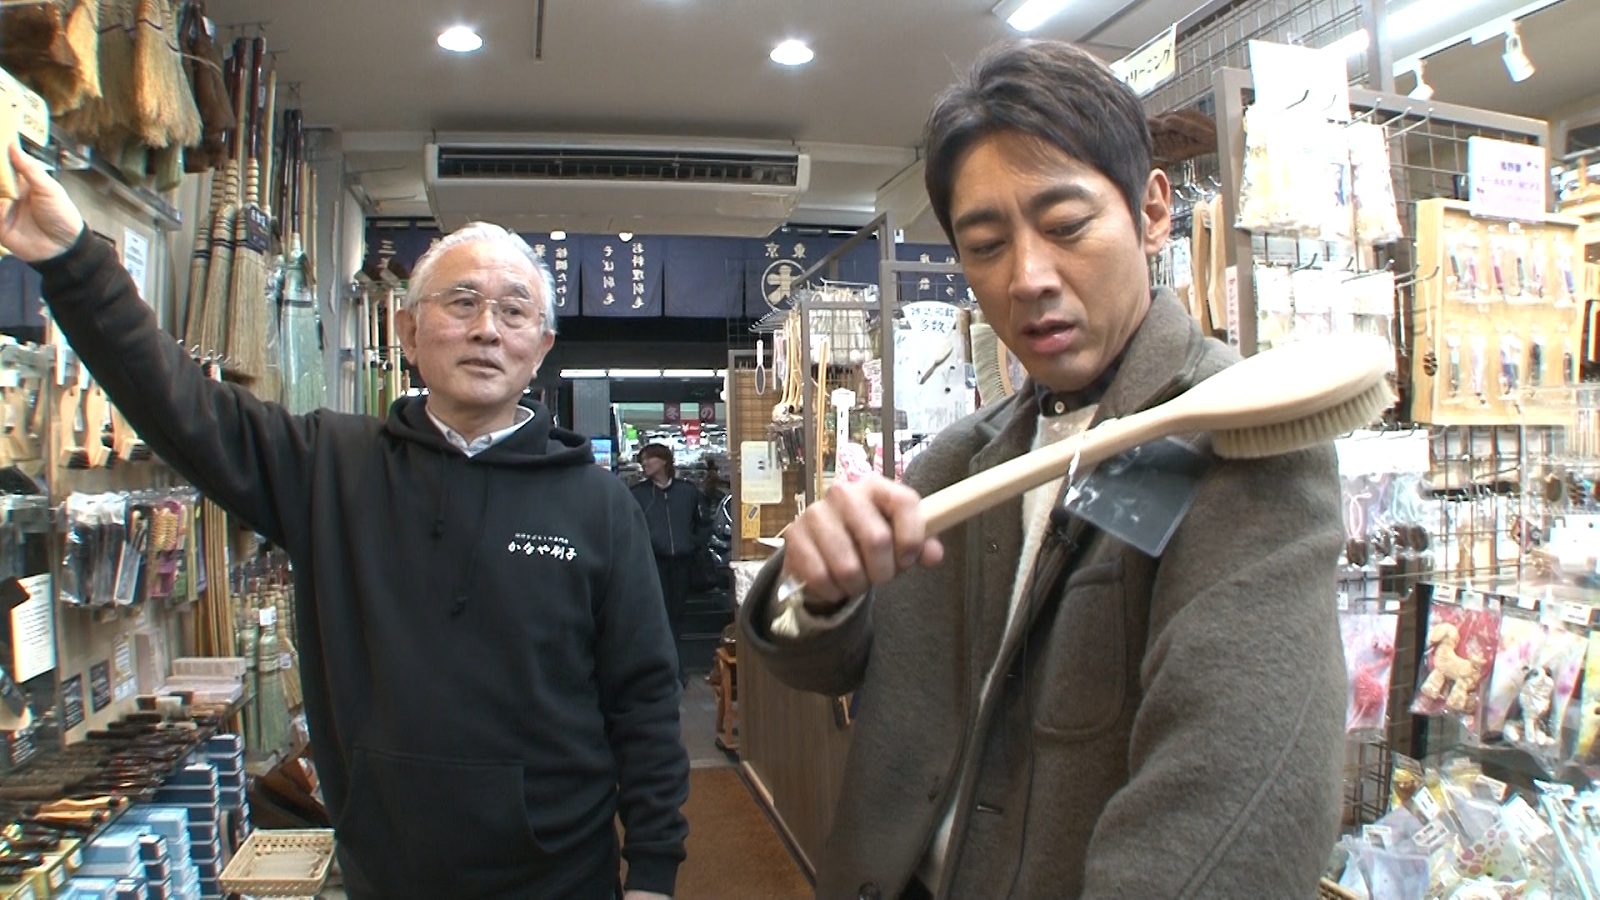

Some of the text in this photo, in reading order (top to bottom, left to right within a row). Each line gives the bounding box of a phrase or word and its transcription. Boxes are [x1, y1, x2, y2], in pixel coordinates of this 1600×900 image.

[508, 541, 577, 561] かなや刷子
